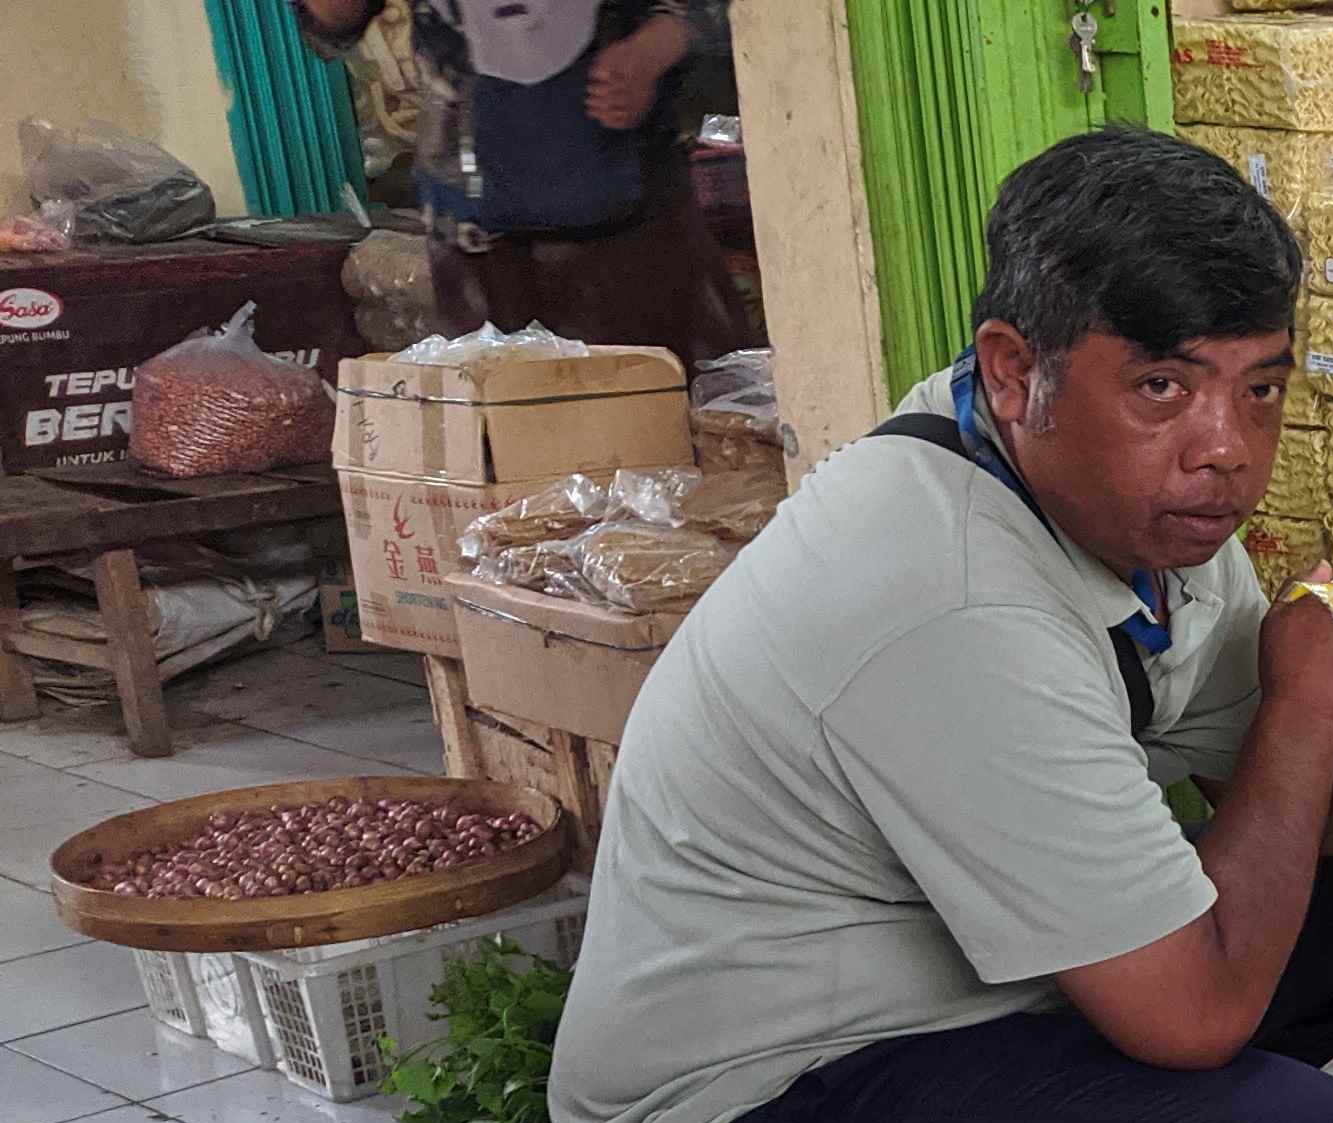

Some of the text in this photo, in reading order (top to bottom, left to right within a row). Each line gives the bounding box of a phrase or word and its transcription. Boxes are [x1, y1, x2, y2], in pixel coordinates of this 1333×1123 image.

[0, 330, 70, 344] PUNG BUMBU
[44, 367, 137, 398] TEPU
[24, 401, 133, 448] BER
